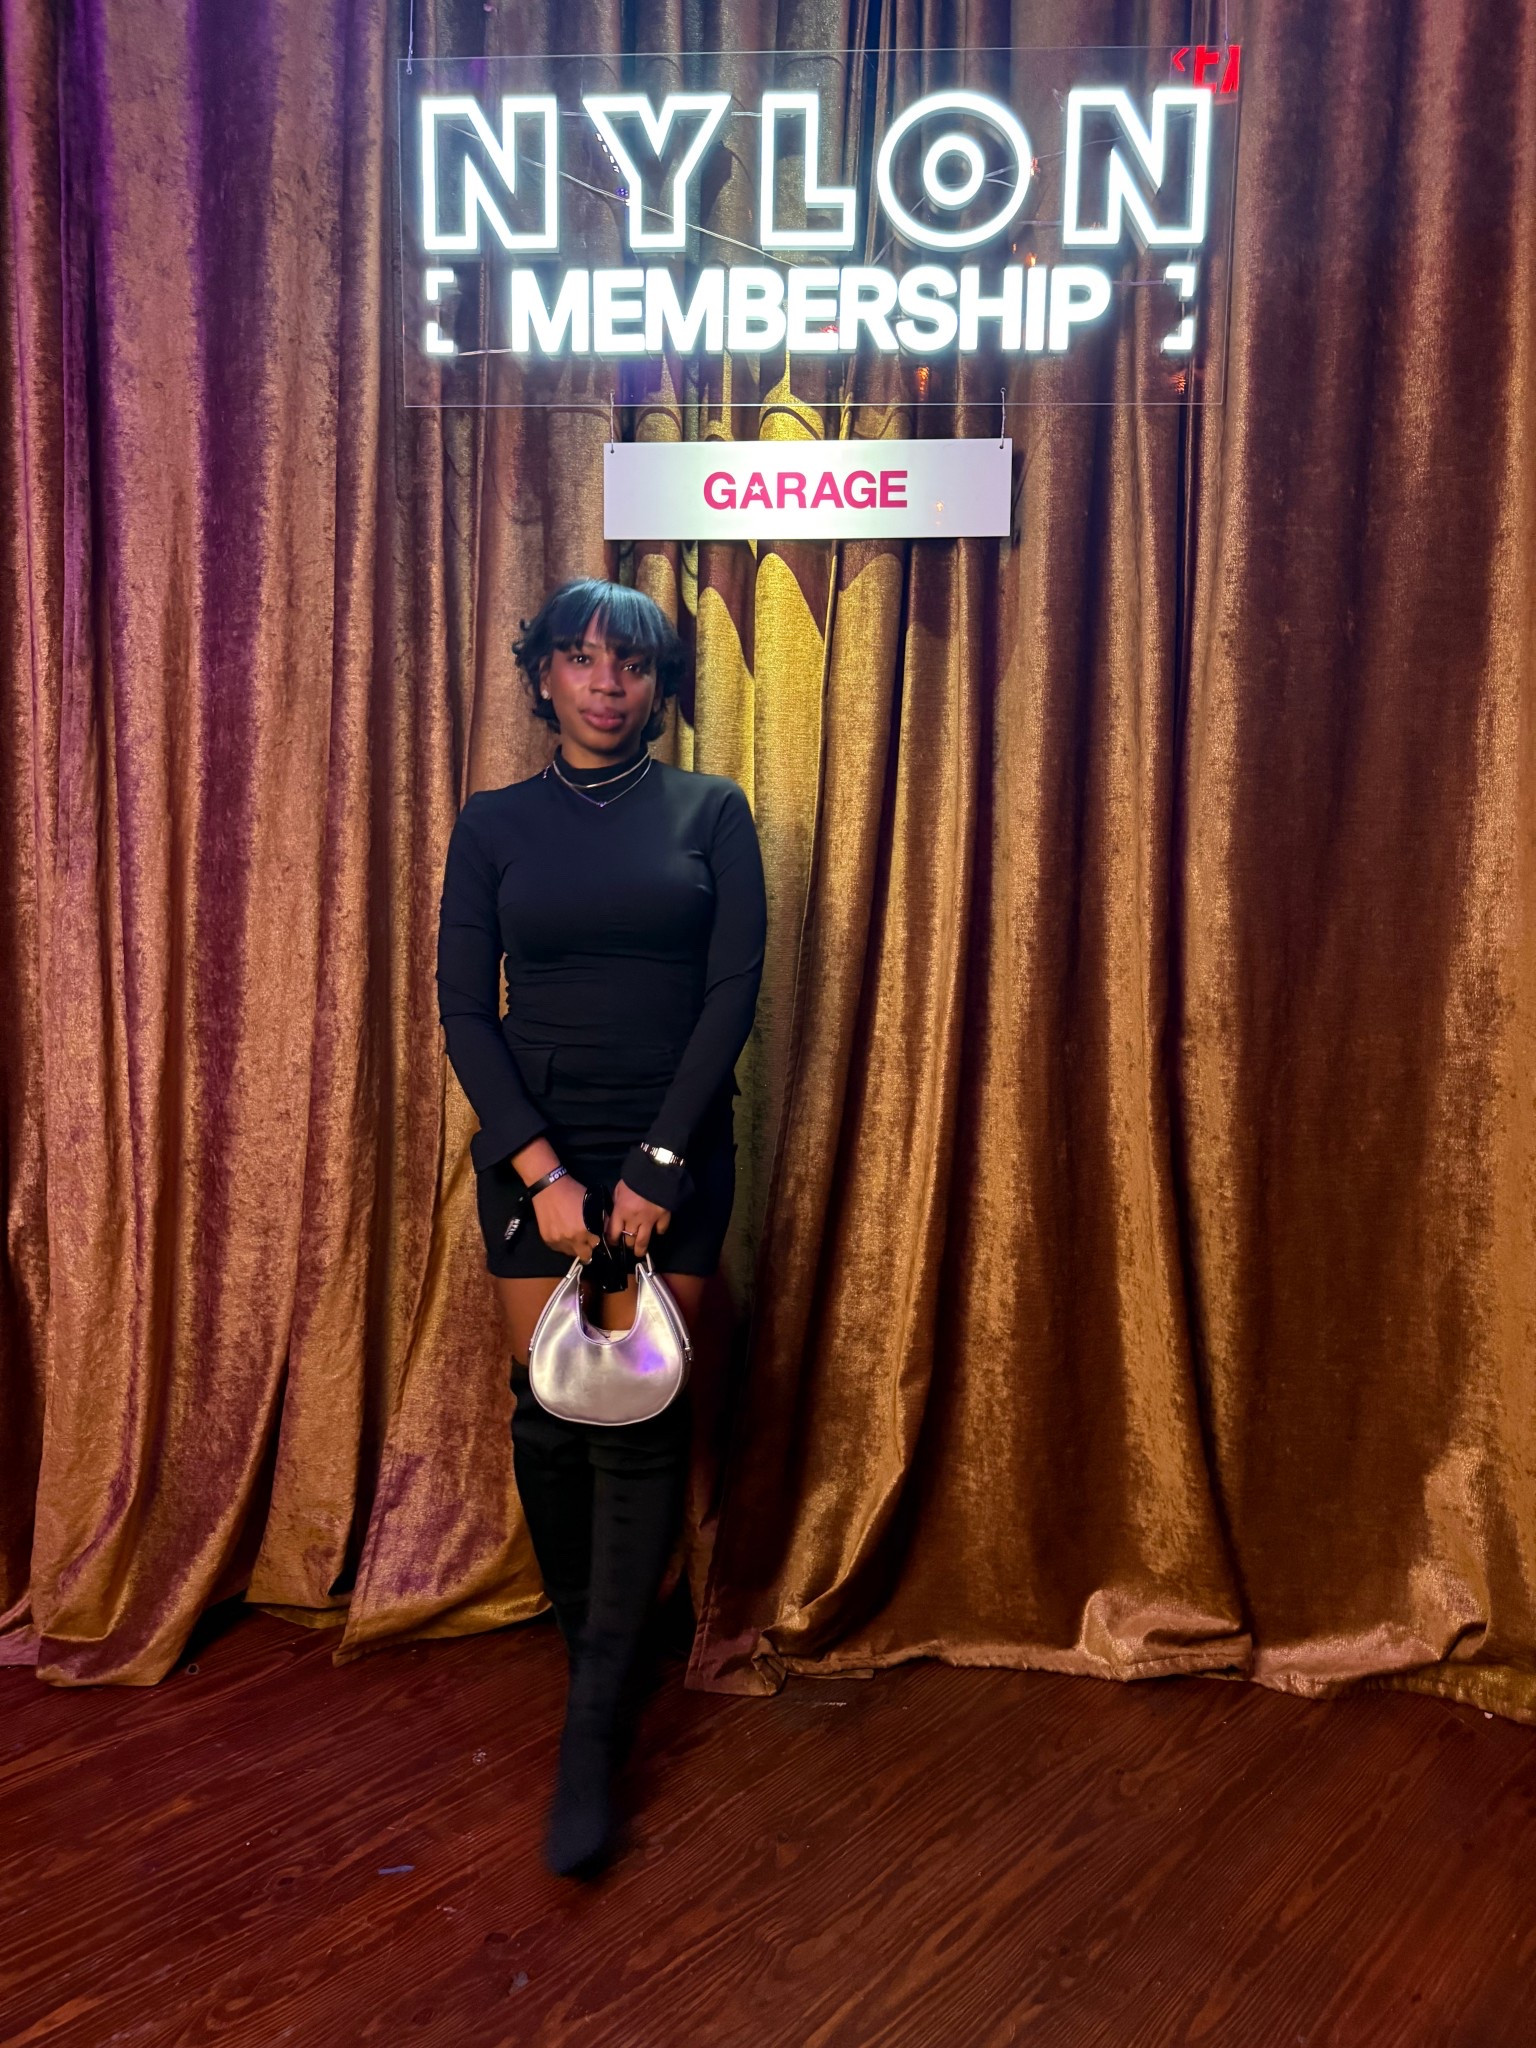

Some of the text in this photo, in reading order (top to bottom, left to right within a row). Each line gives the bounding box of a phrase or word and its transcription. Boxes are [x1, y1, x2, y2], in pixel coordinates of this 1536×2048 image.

[422, 88, 1212, 251] NYLON
[510, 265, 1111, 355] MEMBERSHIP
[703, 470, 908, 510] GARAGE
